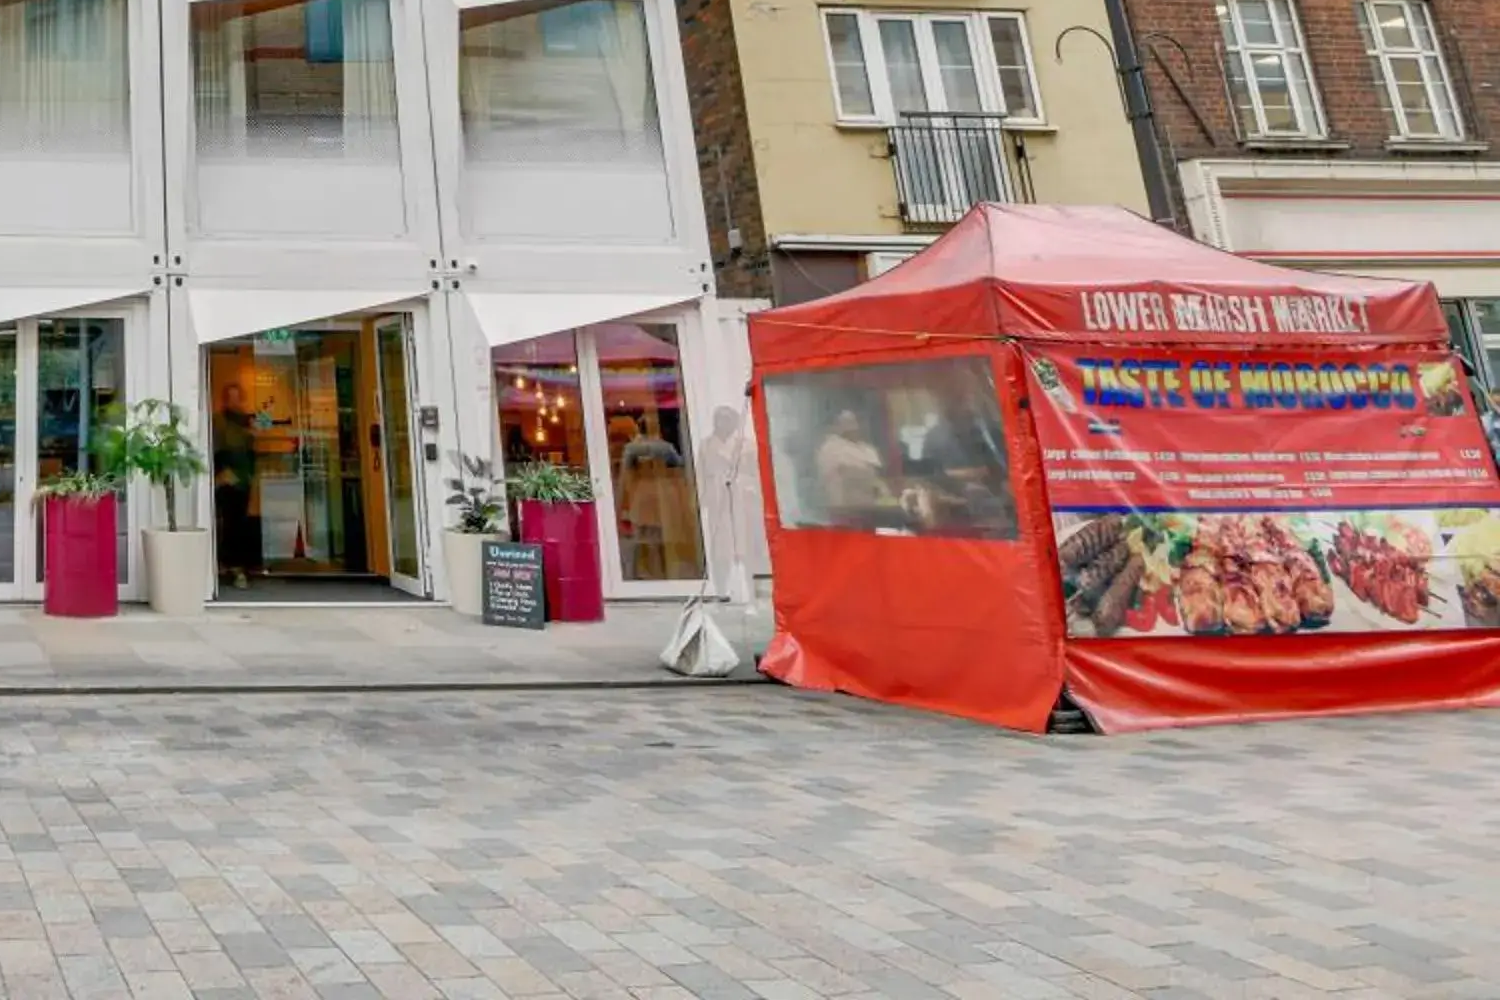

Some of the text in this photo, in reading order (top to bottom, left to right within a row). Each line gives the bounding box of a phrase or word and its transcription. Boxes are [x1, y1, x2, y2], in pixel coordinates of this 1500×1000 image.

[1080, 291, 1370, 333] LOWER MARSH MARKET
[1075, 358, 1417, 409] TASTE OF MOROCCO
